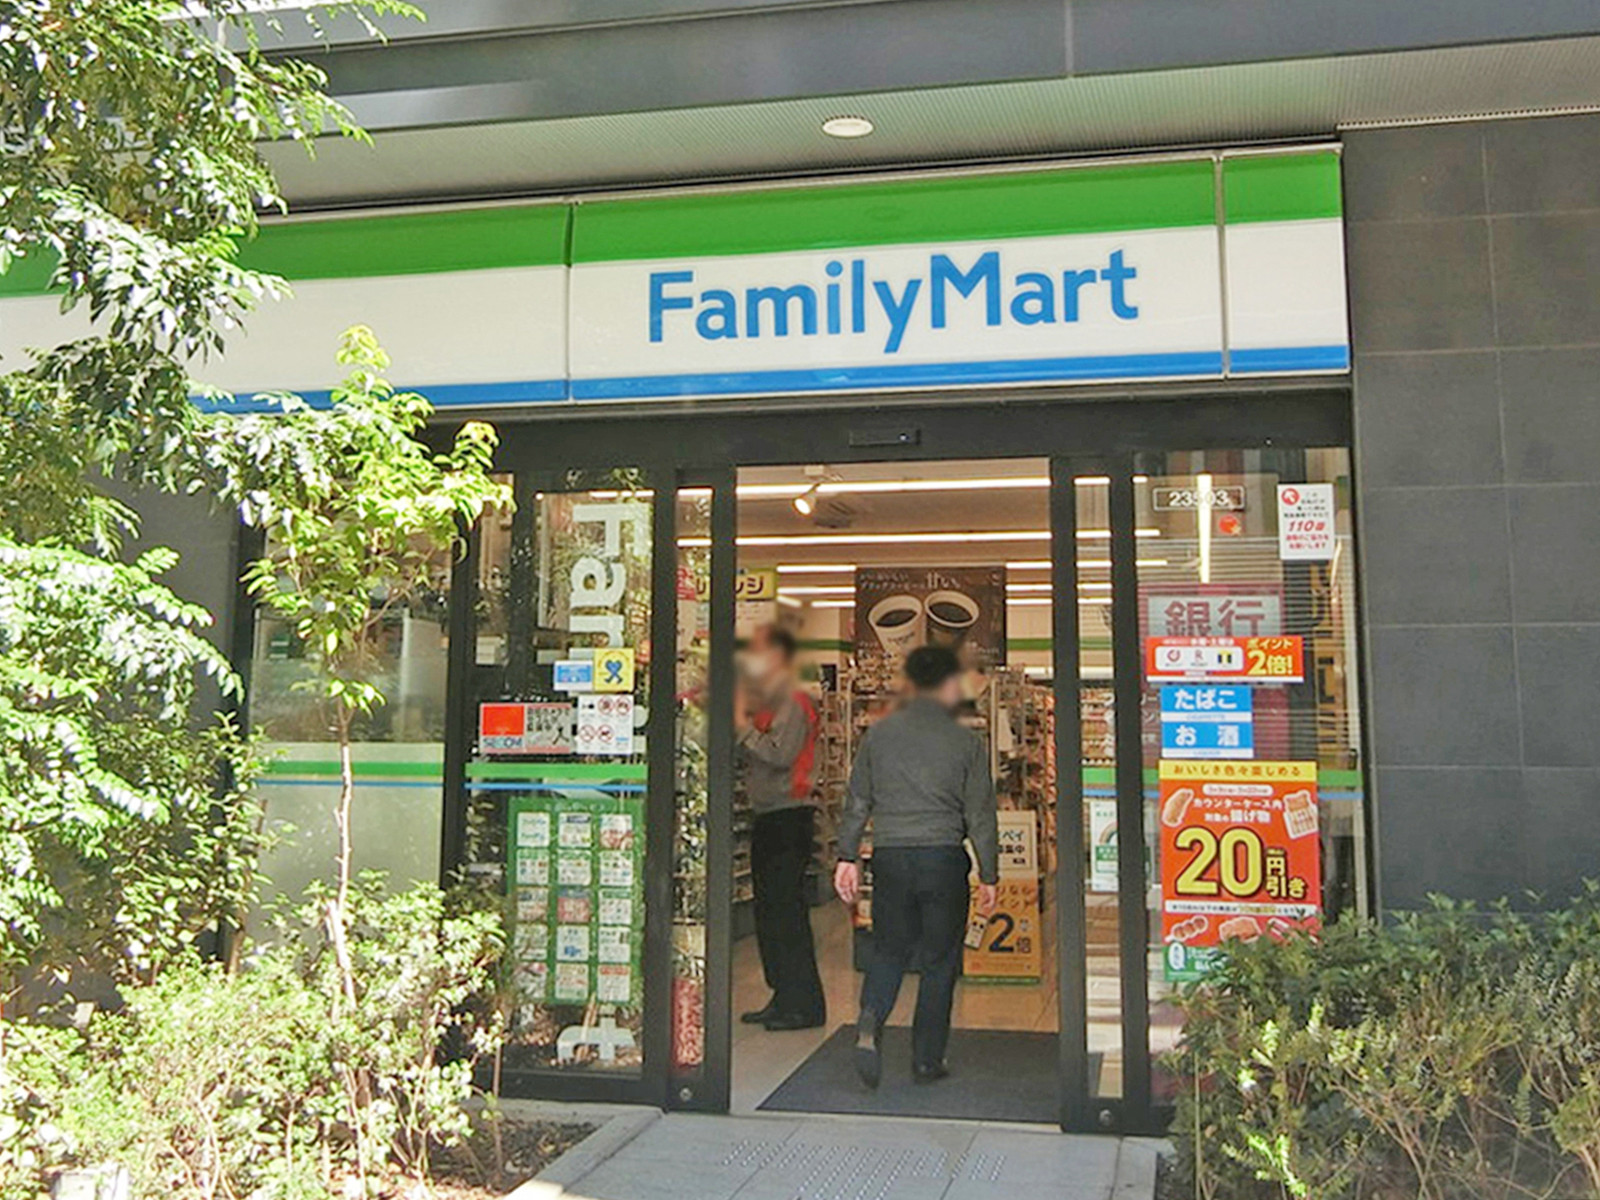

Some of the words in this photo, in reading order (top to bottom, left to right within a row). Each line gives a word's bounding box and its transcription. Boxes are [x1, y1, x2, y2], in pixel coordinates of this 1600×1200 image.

[648, 249, 1139, 353] FamilyMart
[1164, 599, 1265, 638] 銀行
[1247, 638, 1293, 650] ポイント
[1174, 688, 1237, 710] たばこ
[1175, 827, 1263, 897] 20
[988, 913, 1015, 952] 2
